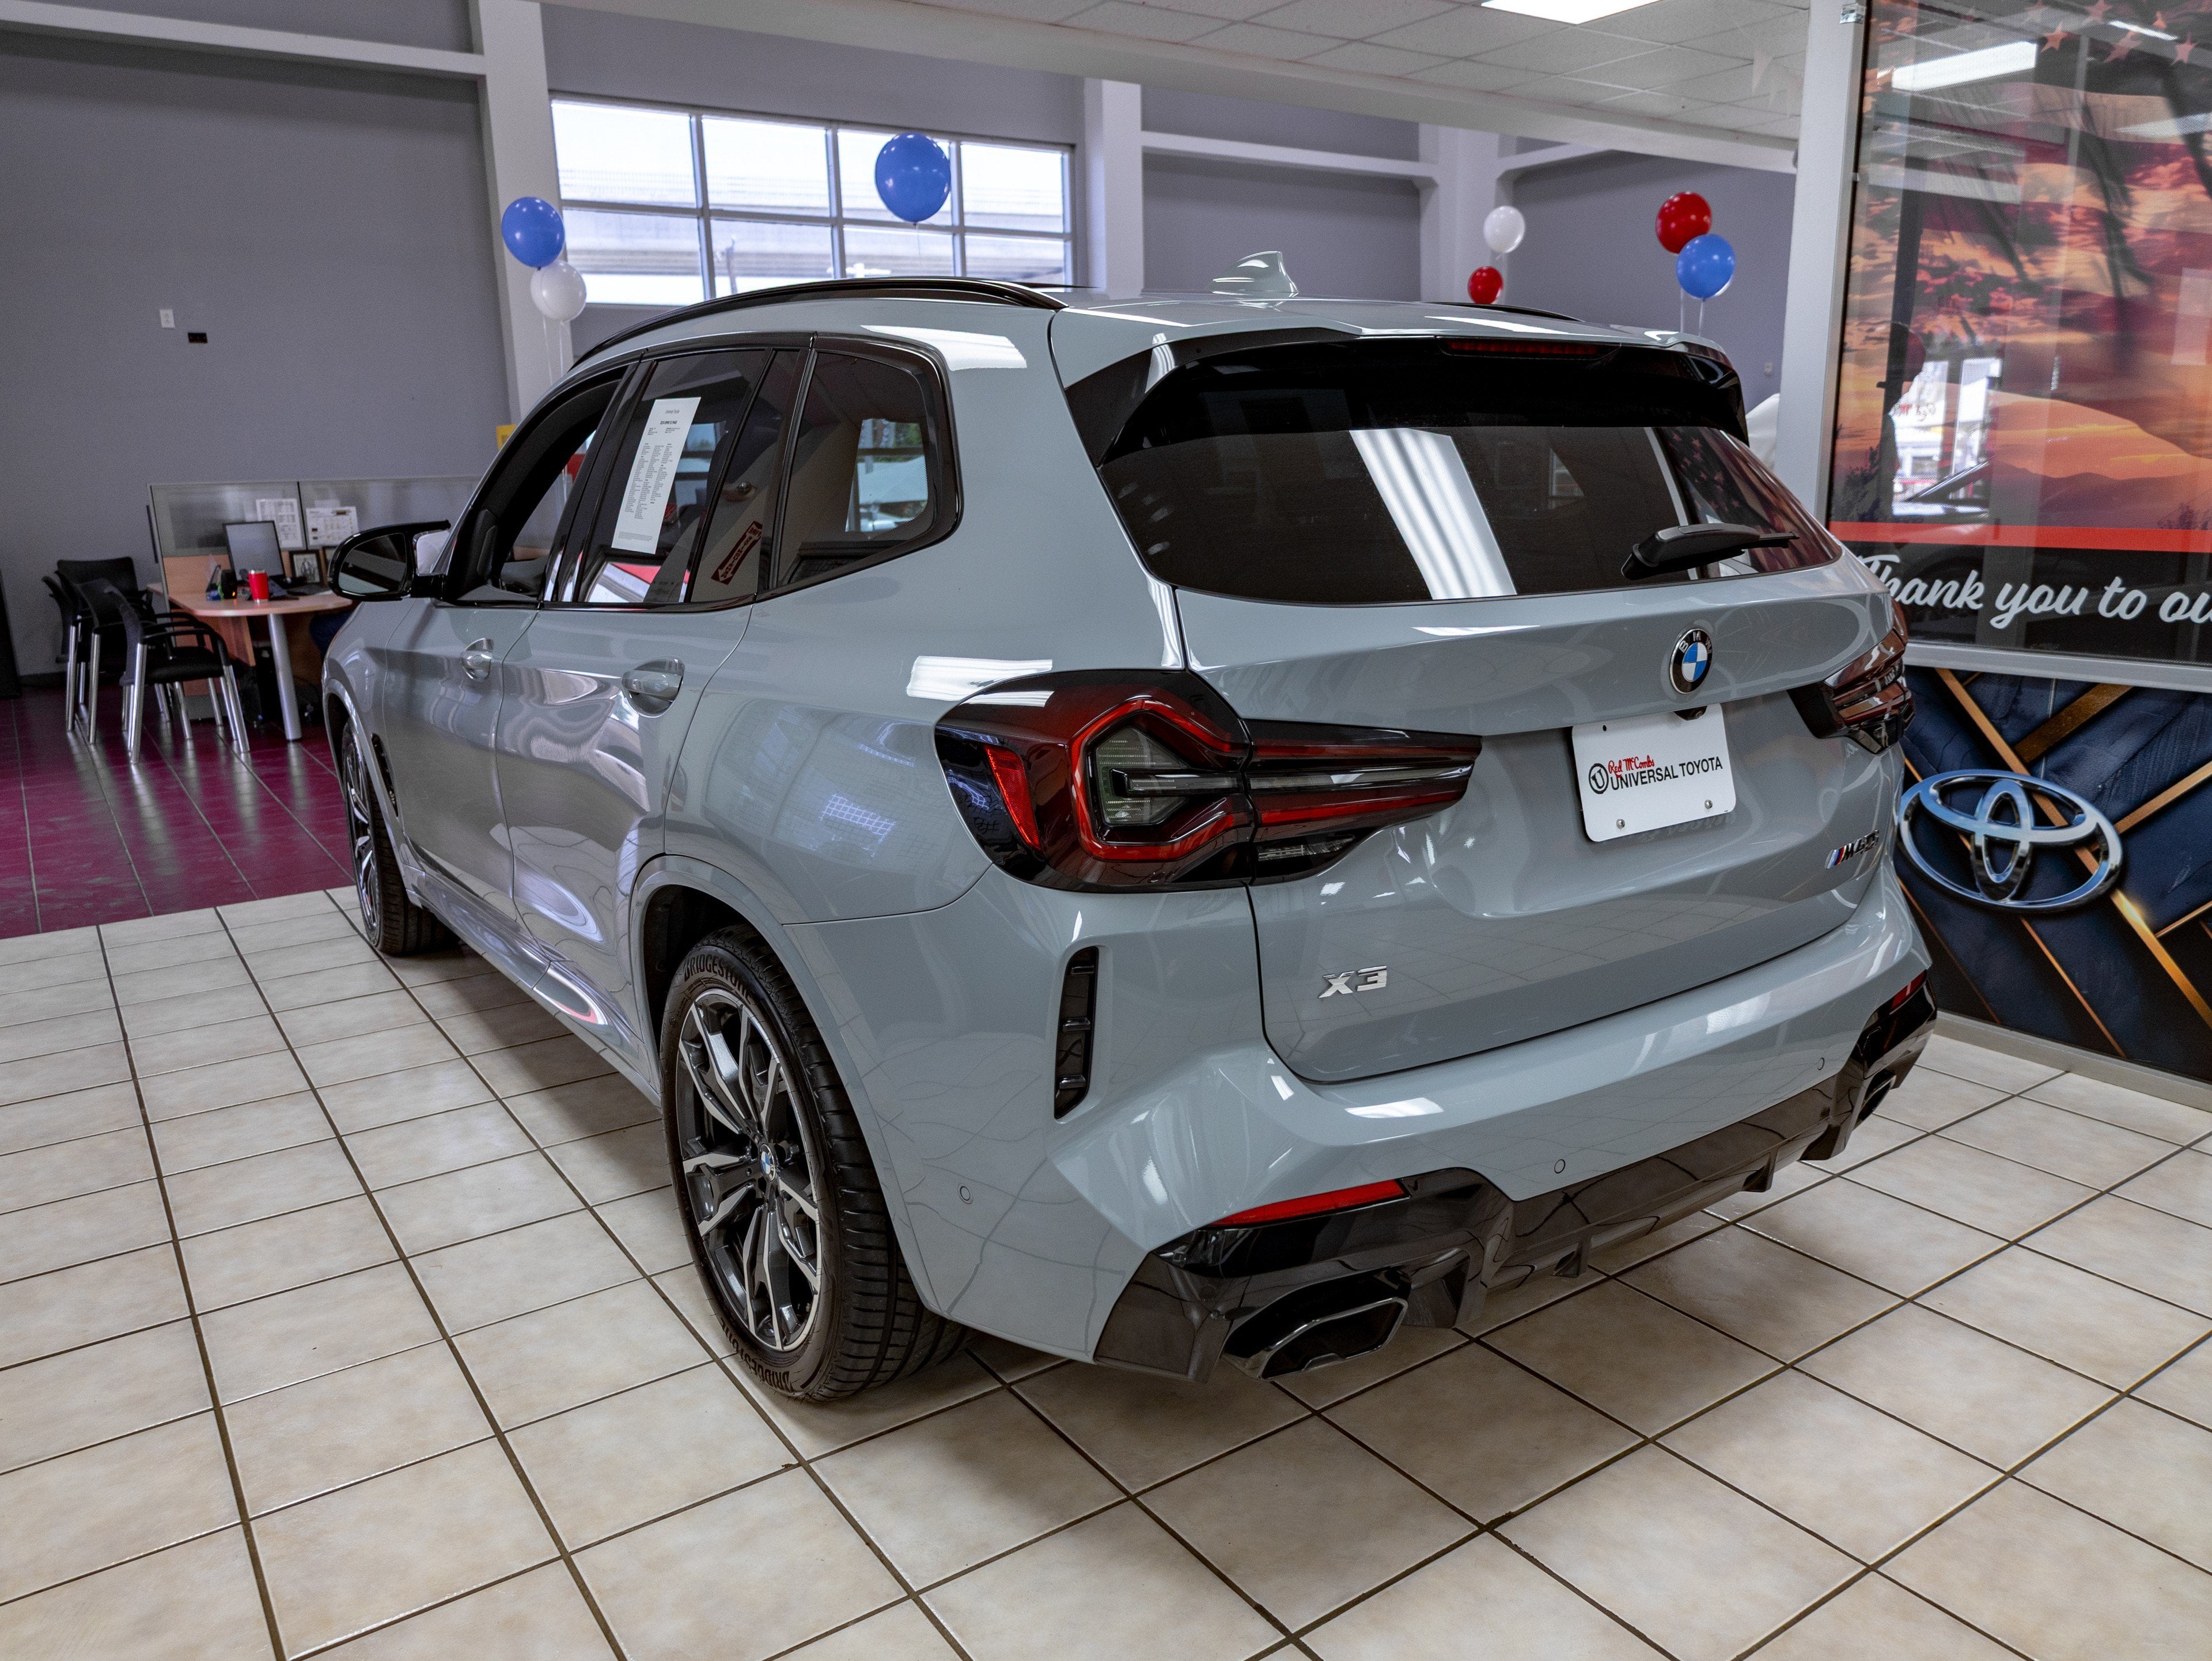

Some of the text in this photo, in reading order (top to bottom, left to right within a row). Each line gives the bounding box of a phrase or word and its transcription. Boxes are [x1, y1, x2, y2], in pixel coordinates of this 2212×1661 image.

[1856, 554, 1985, 611] Thank
[1990, 582, 2089, 629] you
[2098, 576, 2147, 620] to
[1608, 754, 1655, 776] Red McCombs
[1610, 756, 1724, 790] UNIVERSAL TOYOTA
[1318, 965, 1388, 998] X3
